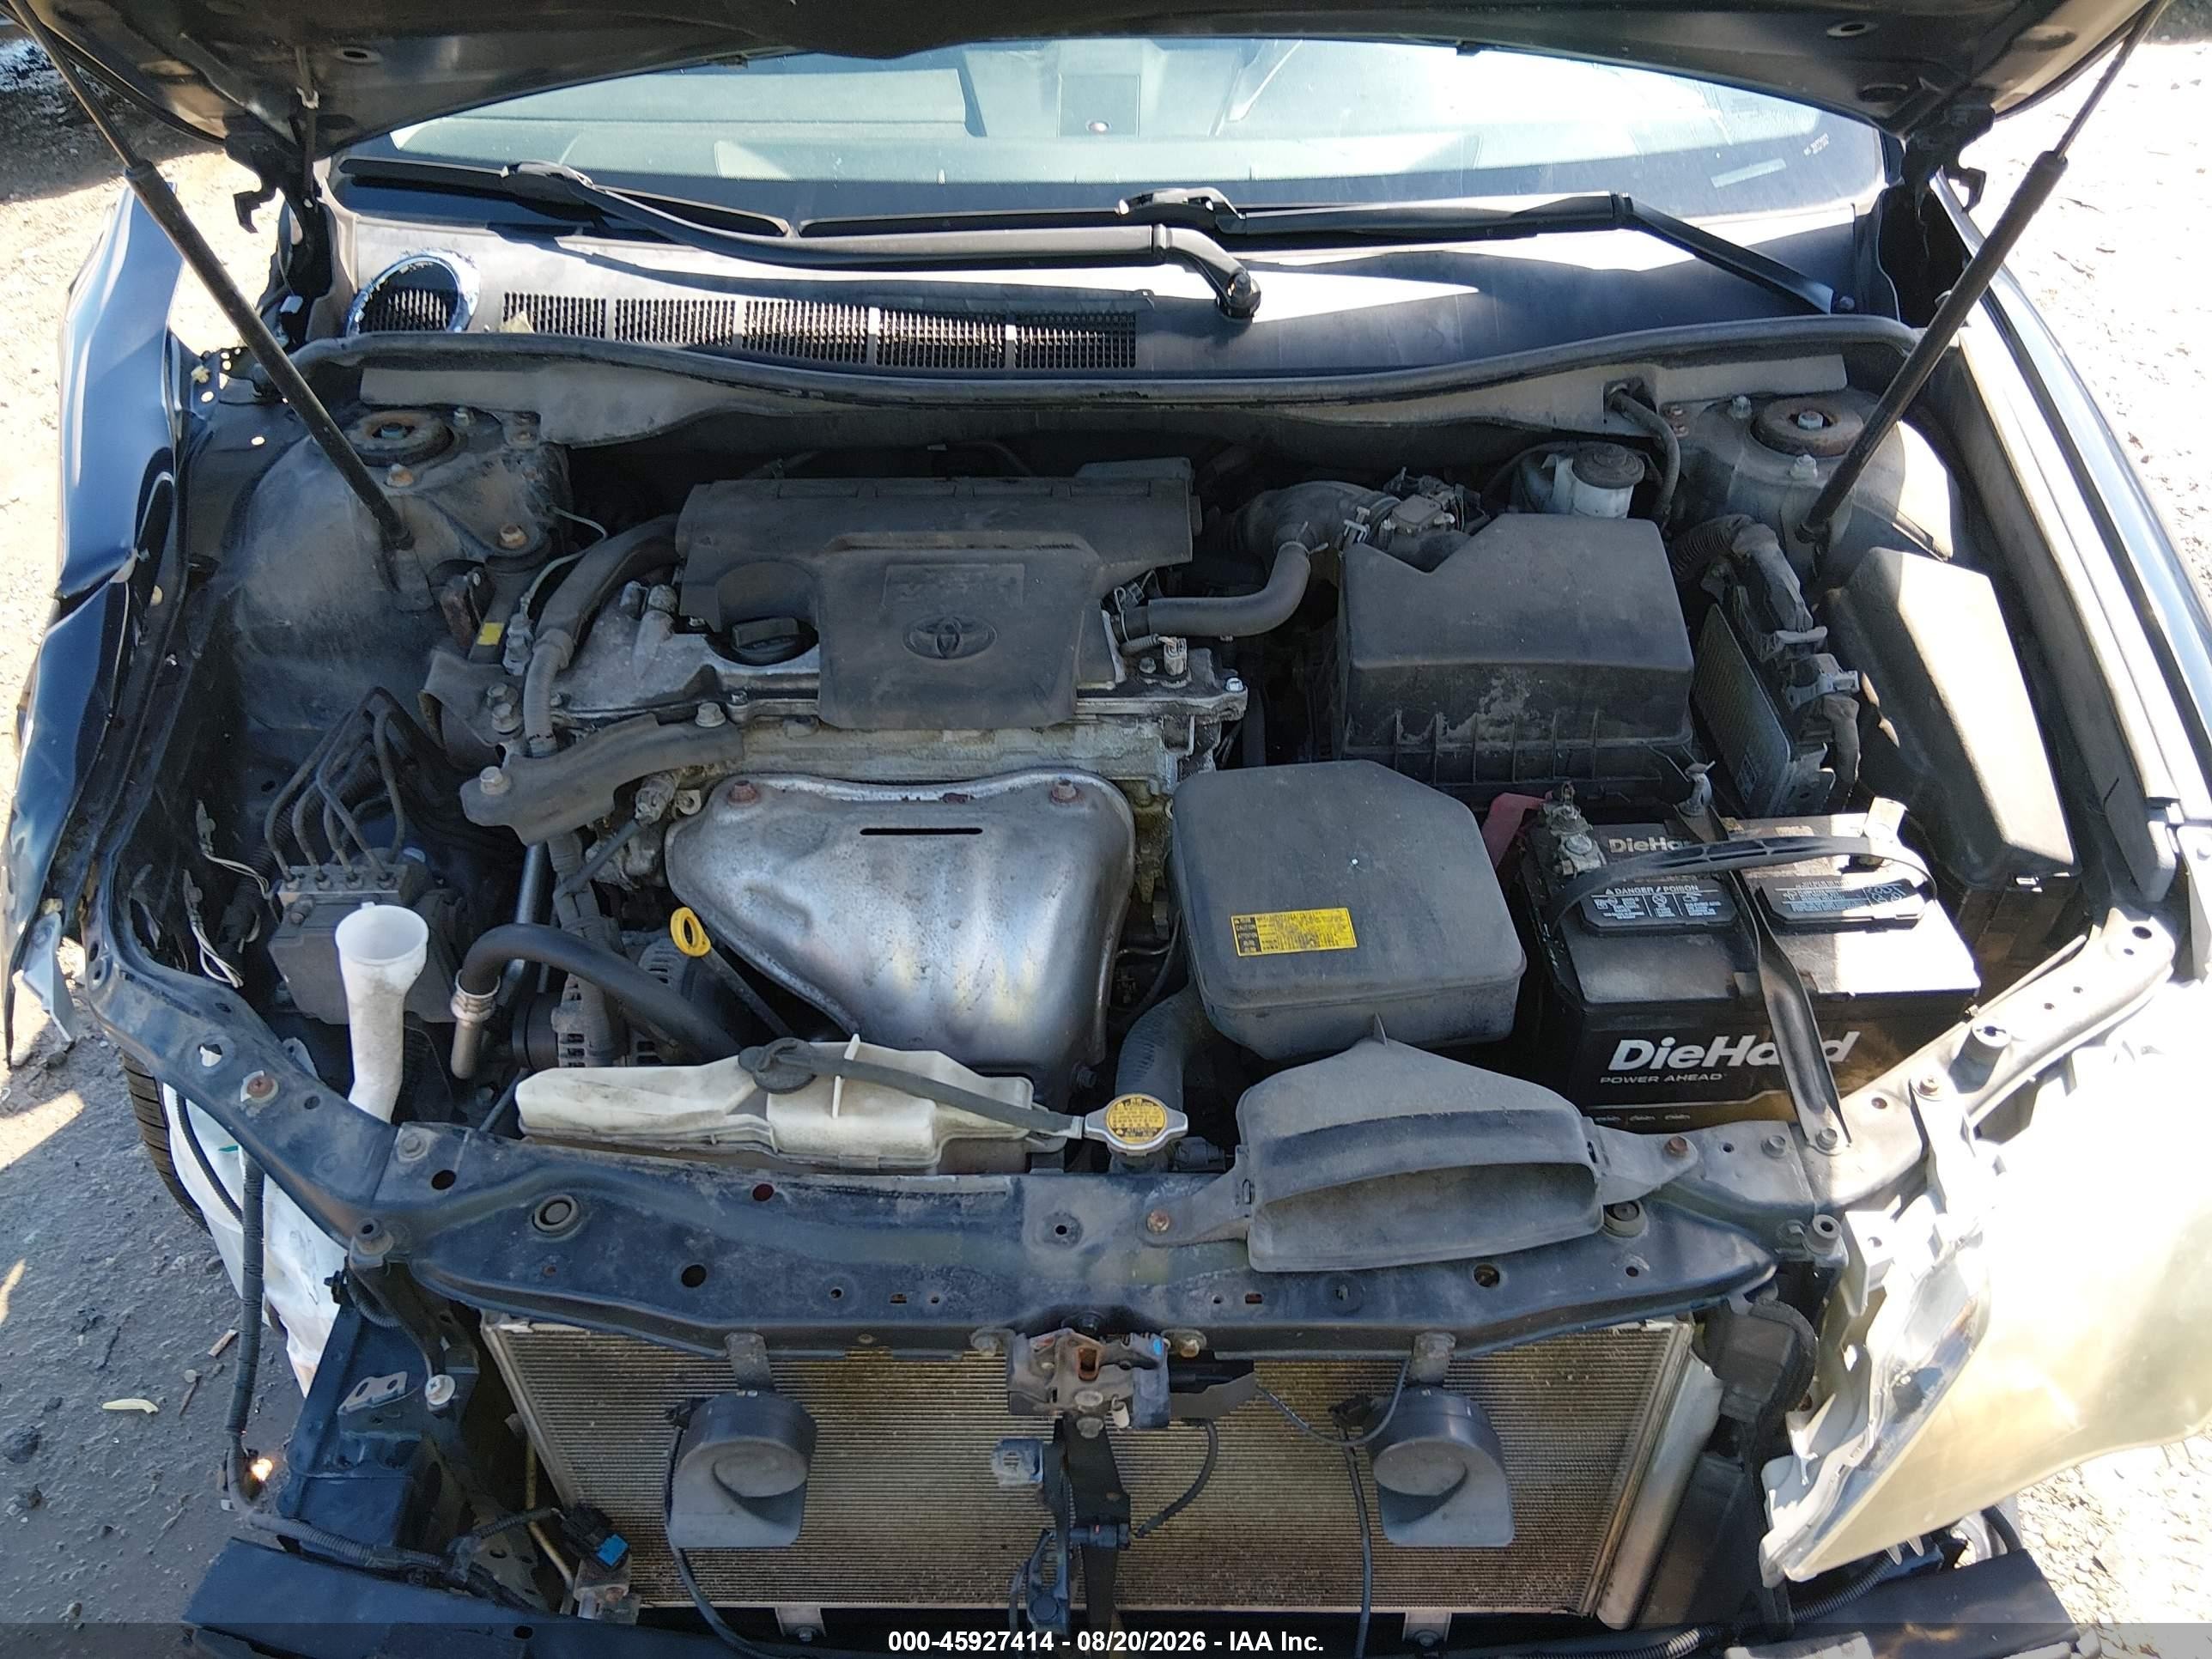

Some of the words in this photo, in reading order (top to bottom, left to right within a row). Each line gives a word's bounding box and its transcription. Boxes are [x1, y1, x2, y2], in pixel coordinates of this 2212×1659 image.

[1614, 886, 1654, 896] DANGER
[1662, 884, 1699, 894] POISON
[1600, 1074, 1660, 1085] POWER
[1663, 1073, 1723, 1082] AHEAD
